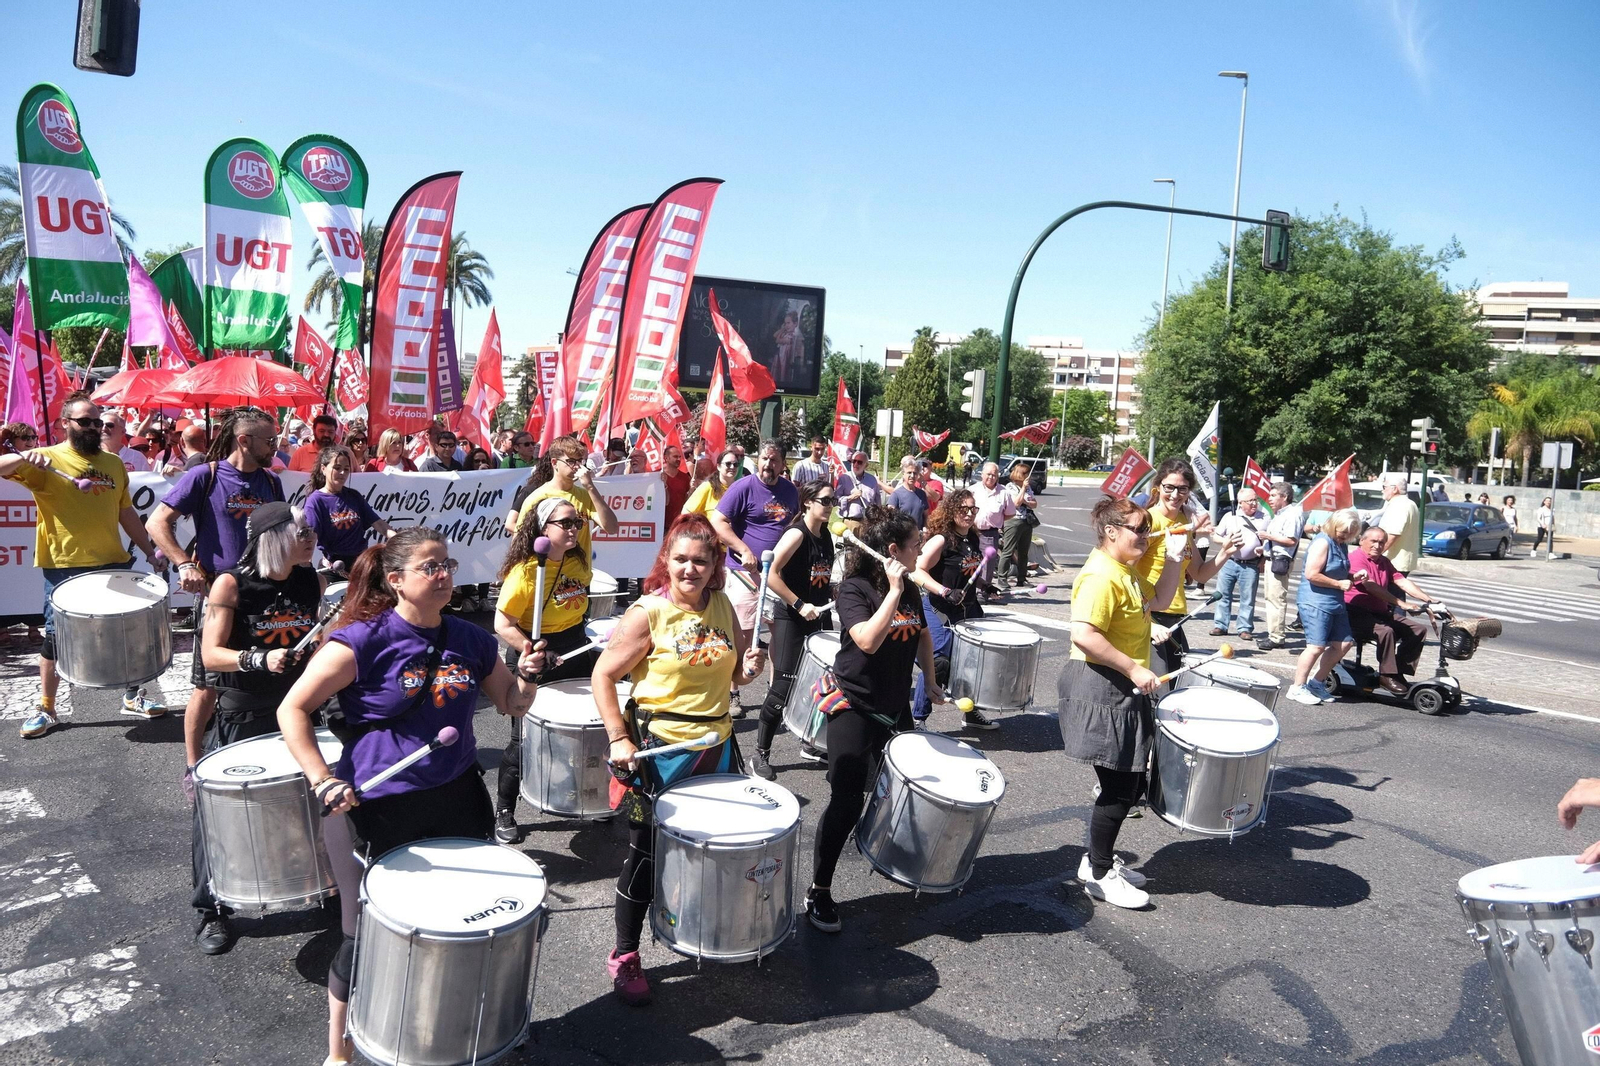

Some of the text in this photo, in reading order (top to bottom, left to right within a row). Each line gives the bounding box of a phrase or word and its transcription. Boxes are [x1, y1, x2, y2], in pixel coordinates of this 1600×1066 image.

[234, 157, 270, 181] UGT
[216, 233, 292, 273] UGT
[391, 205, 447, 368] CCOO
[636, 202, 703, 358] CCOO
[388, 408, 427, 419] Córdoba
[440, 481, 504, 516] bajar
[980, 776, 991, 794] LUEN
[758, 791, 782, 808] LUEN
[463, 905, 506, 924] LUEN
